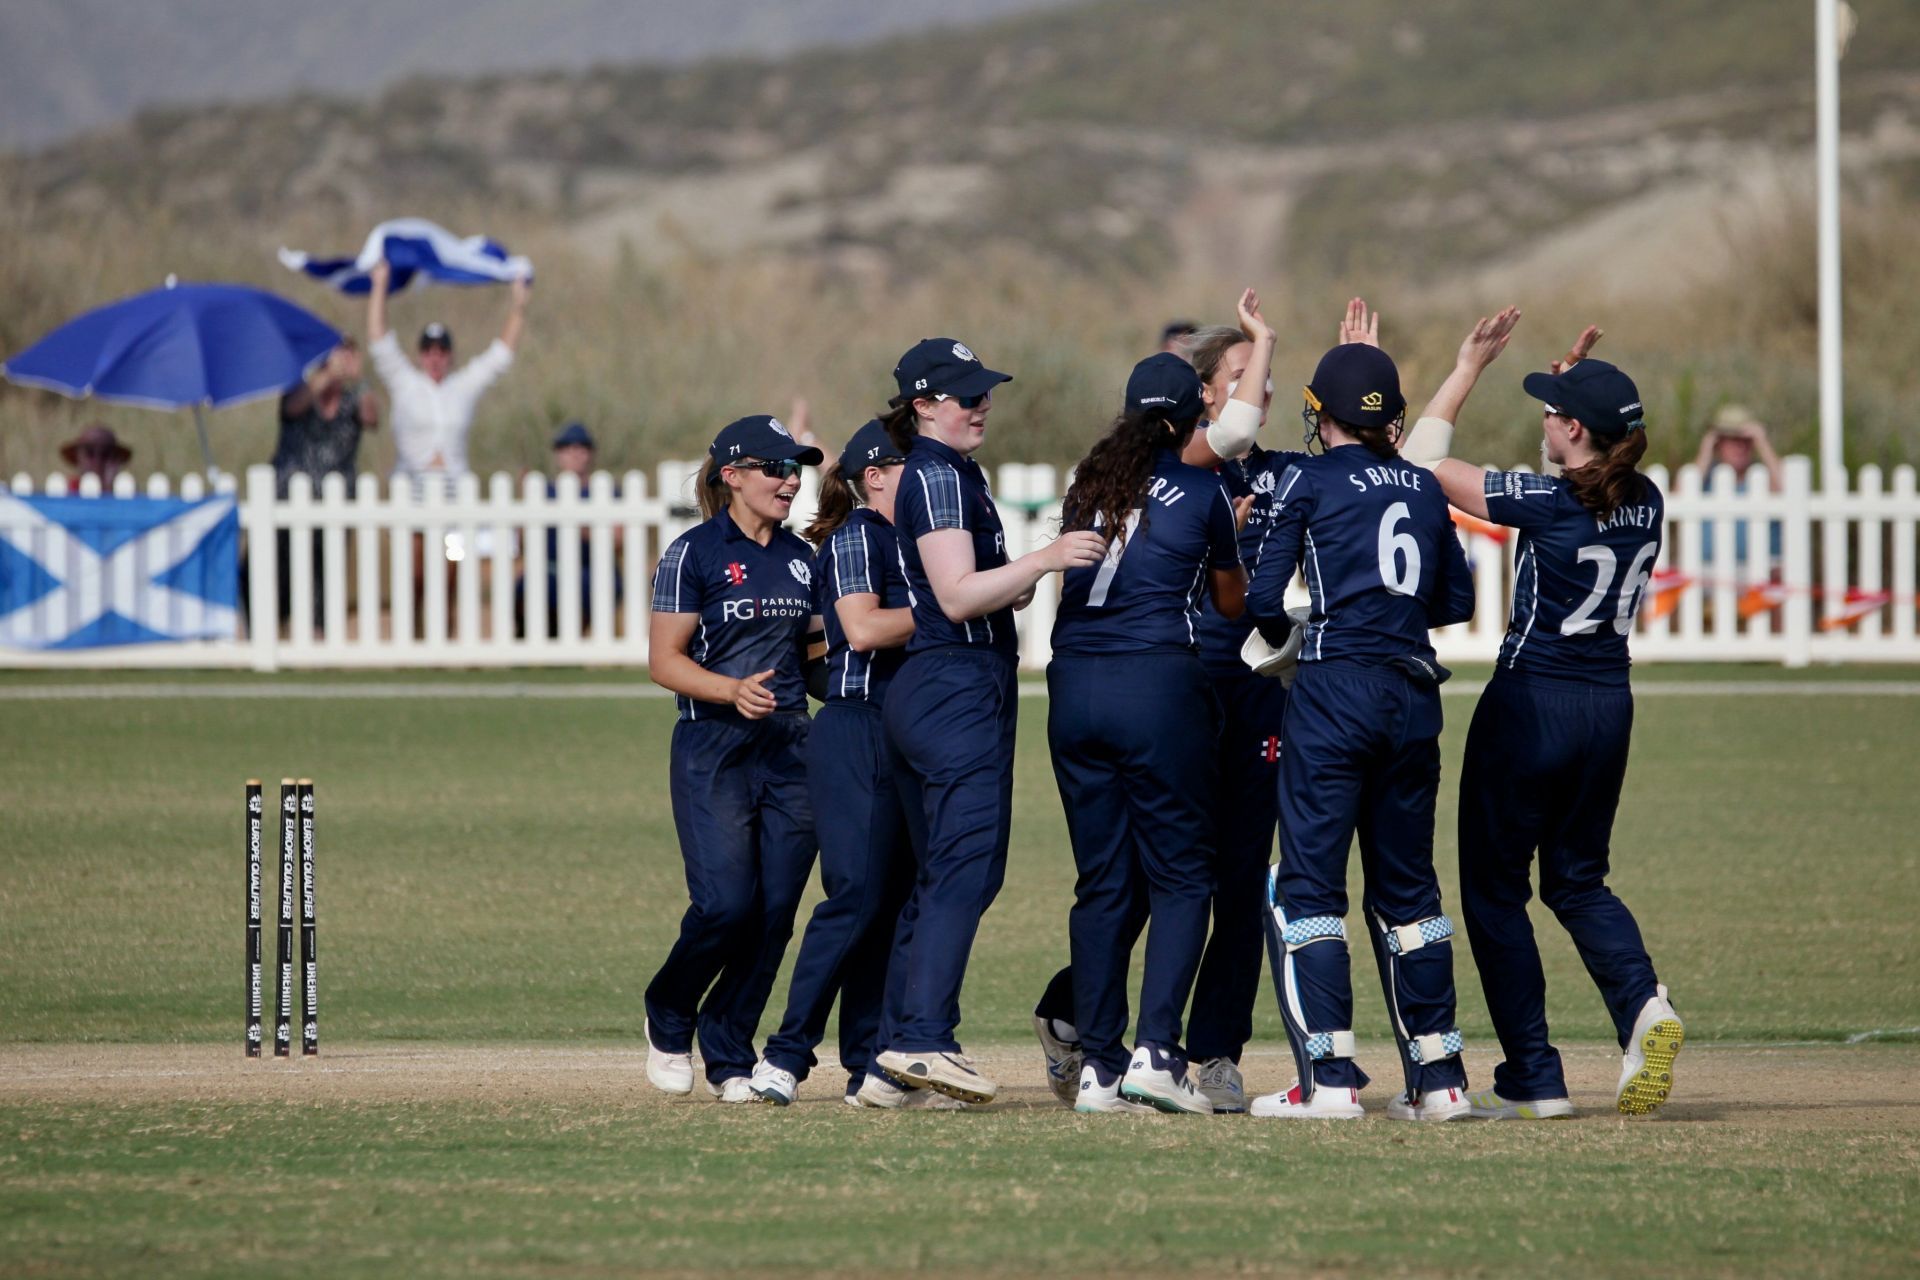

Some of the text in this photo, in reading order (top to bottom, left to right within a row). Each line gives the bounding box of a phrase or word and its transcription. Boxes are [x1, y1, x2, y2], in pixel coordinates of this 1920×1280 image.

[915, 378, 928, 390] 63
[729, 444, 741, 456] 71
[867, 446, 880, 460] 37
[1350, 466, 1421, 492] S BRYCE
[1086, 508, 1143, 607] 7
[1378, 501, 1421, 597] 6
[722, 599, 755, 622] PG
[1560, 541, 1658, 637] 26
[762, 608, 803, 618] GROUP
[251, 818, 261, 862] EUROPE
[284, 818, 294, 862] EUROPE
[303, 818, 313, 862] EUROPE
[251, 862, 261, 919] QUALIFIER
[282, 862, 294, 919] QUALIFIER
[303, 862, 314, 918] QUALIFIER
